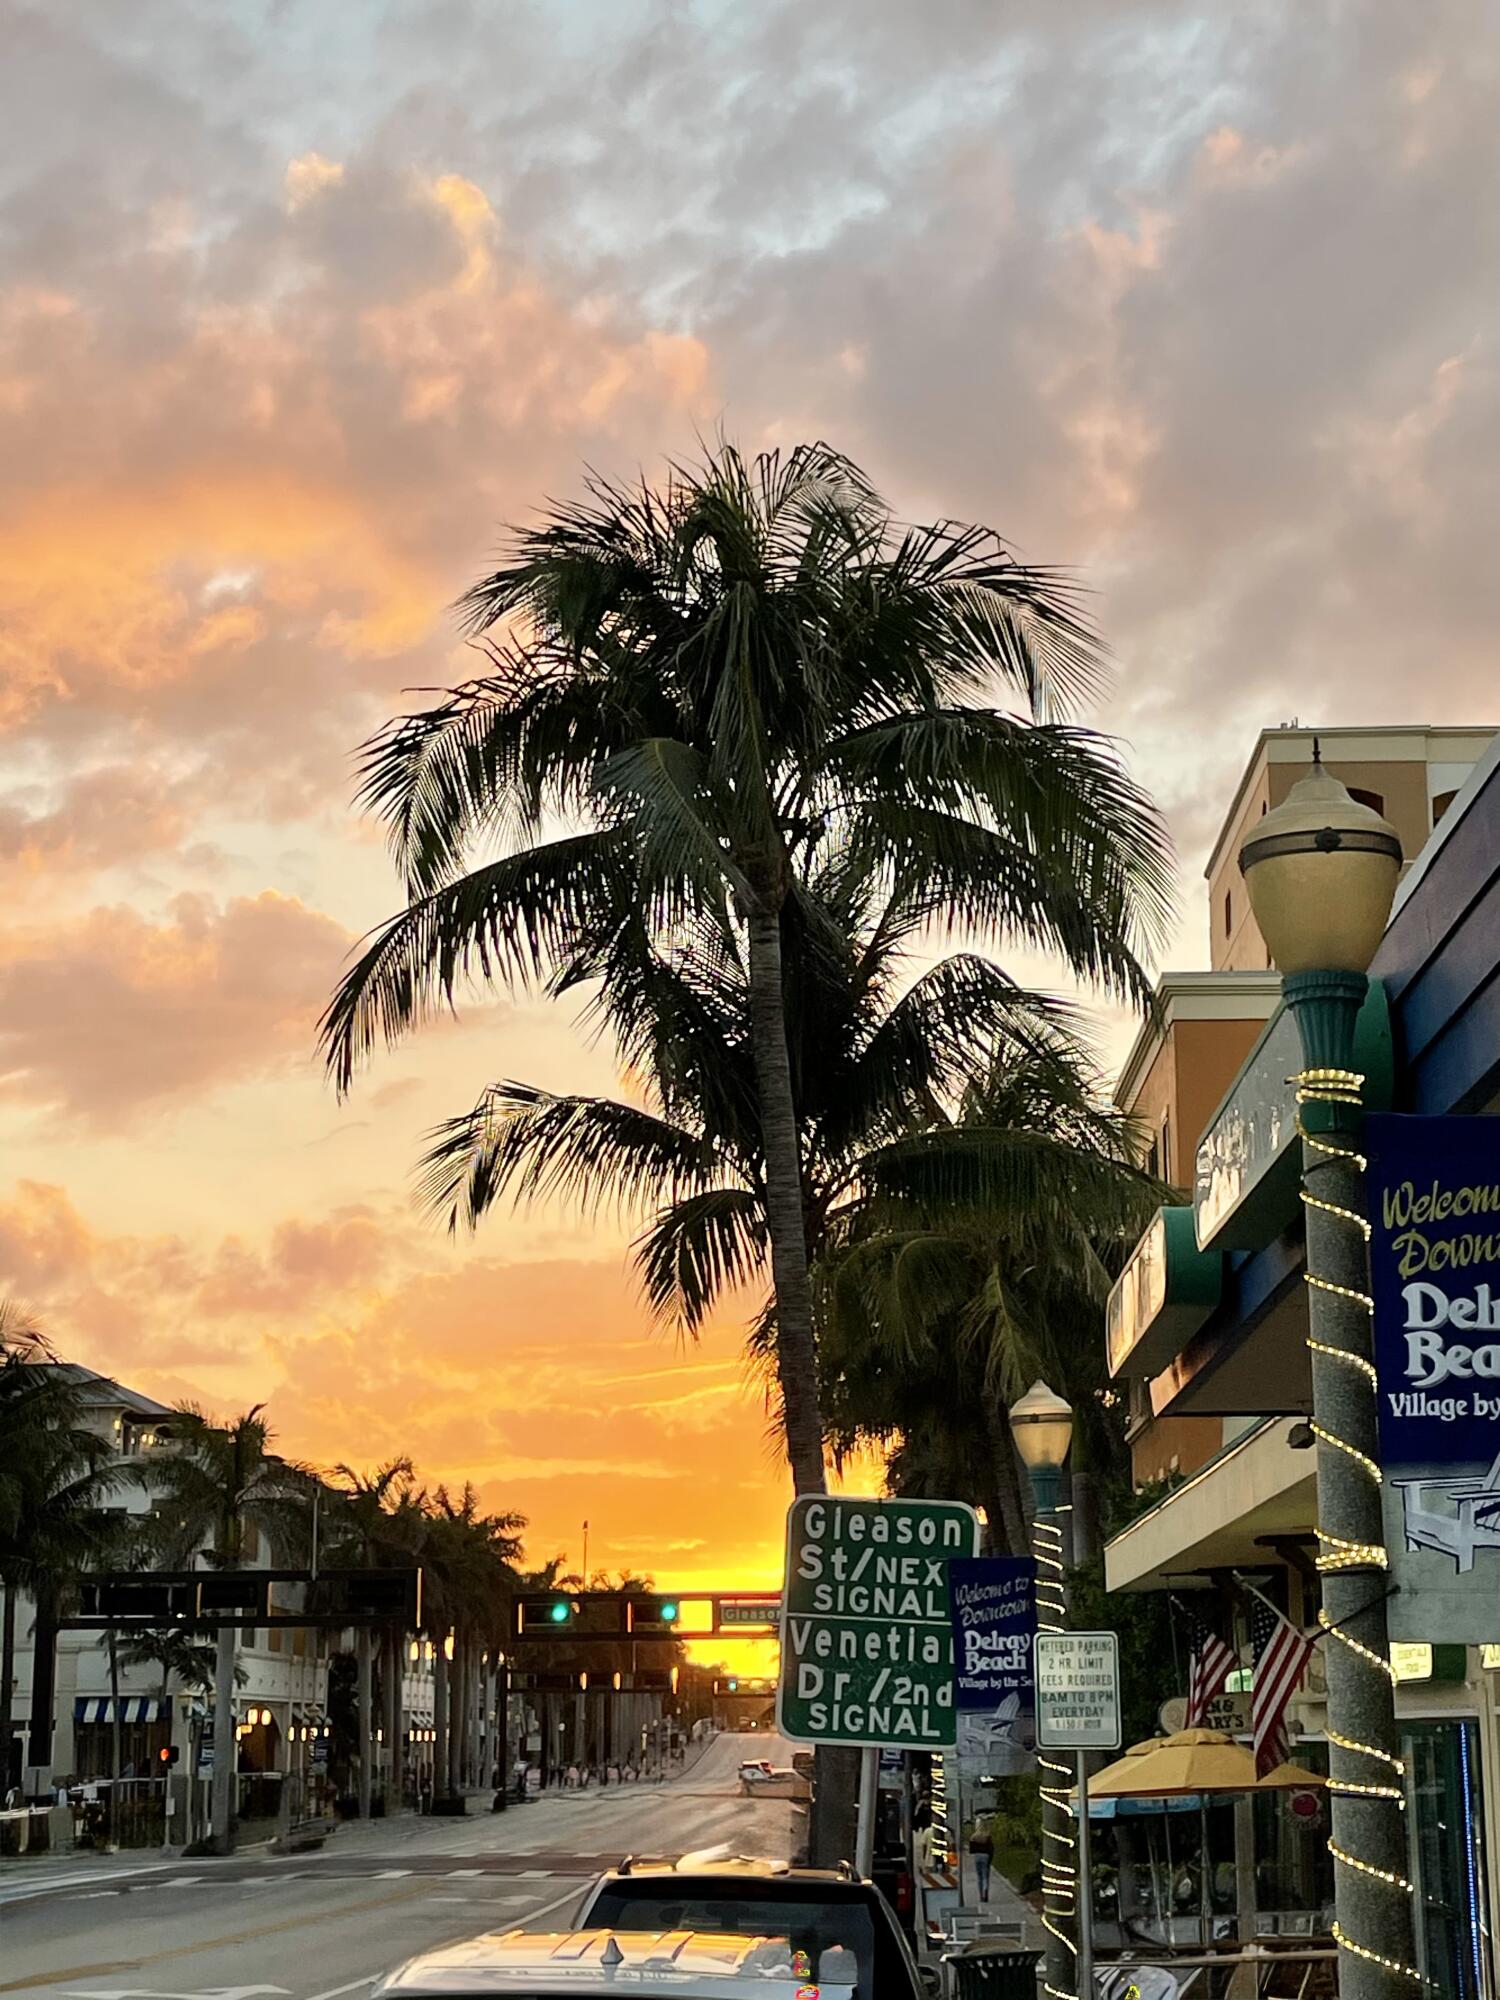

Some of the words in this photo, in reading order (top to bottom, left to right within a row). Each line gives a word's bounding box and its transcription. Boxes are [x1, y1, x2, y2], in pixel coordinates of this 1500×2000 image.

[1383, 1180, 1500, 1230] Welcom
[1392, 1228, 1500, 1280] Down
[1403, 1330, 1500, 1388] Bea
[1388, 1392, 1468, 1421] Village
[1472, 1392, 1500, 1421] by
[804, 1504, 961, 1547] Gleason
[812, 1584, 946, 1617] SIGNAL
[955, 1581, 1011, 1606] Welcome
[1015, 1577, 1029, 1592] to
[960, 1599, 1031, 1627] Downtown
[964, 1630, 1030, 1653] Delray
[1041, 1641, 1074, 1653] METERED
[1078, 1641, 1112, 1653] PARKING
[964, 1649, 1026, 1675] Beach
[1049, 1658, 1055, 1670] 2
[1078, 1658, 1103, 1670] LIMIT
[797, 1663, 851, 1700] Dr
[958, 1677, 988, 1691] Village
[990, 1677, 1002, 1690] by
[1003, 1676, 1019, 1688] the
[1041, 1674, 1063, 1686] FEES
[1068, 1674, 1113, 1686] REQUIRED
[808, 1703, 941, 1737] SIGNAL
[1052, 1706, 1105, 1718] EVERYDAY
